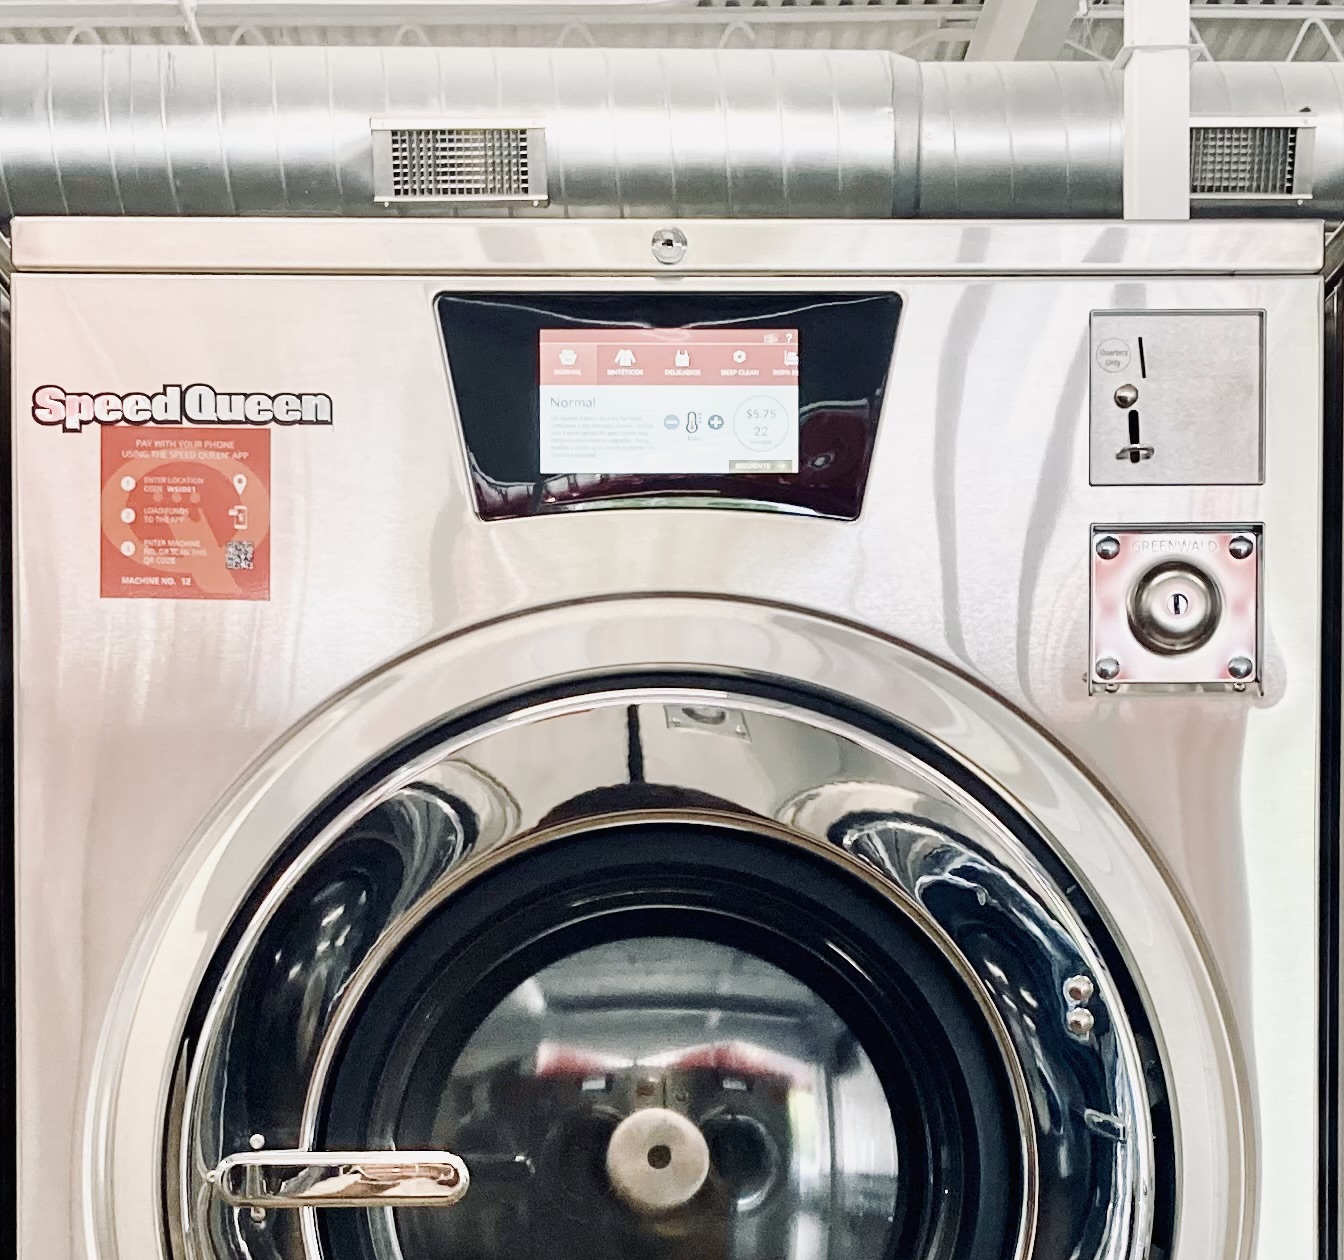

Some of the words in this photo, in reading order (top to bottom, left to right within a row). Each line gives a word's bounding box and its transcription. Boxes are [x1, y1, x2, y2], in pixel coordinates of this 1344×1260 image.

[550, 396, 596, 408] Normal
[746, 408, 776, 420] $5.75
[754, 426, 768, 437] 22
[136, 439, 153, 448] PAY
[154, 440, 176, 448] WITH
[179, 440, 203, 449] YOUR
[204, 440, 235, 450] PHONE
[122, 450, 150, 459] USING
[152, 450, 168, 459] THE
[170, 451, 196, 459] SPEED
[232, 452, 249, 460] APP
[1131, 540, 1218, 553] GREENWALD
[121, 577, 159, 586] MACHINE
[161, 577, 176, 586] NO.
[181, 577, 192, 586] 12
